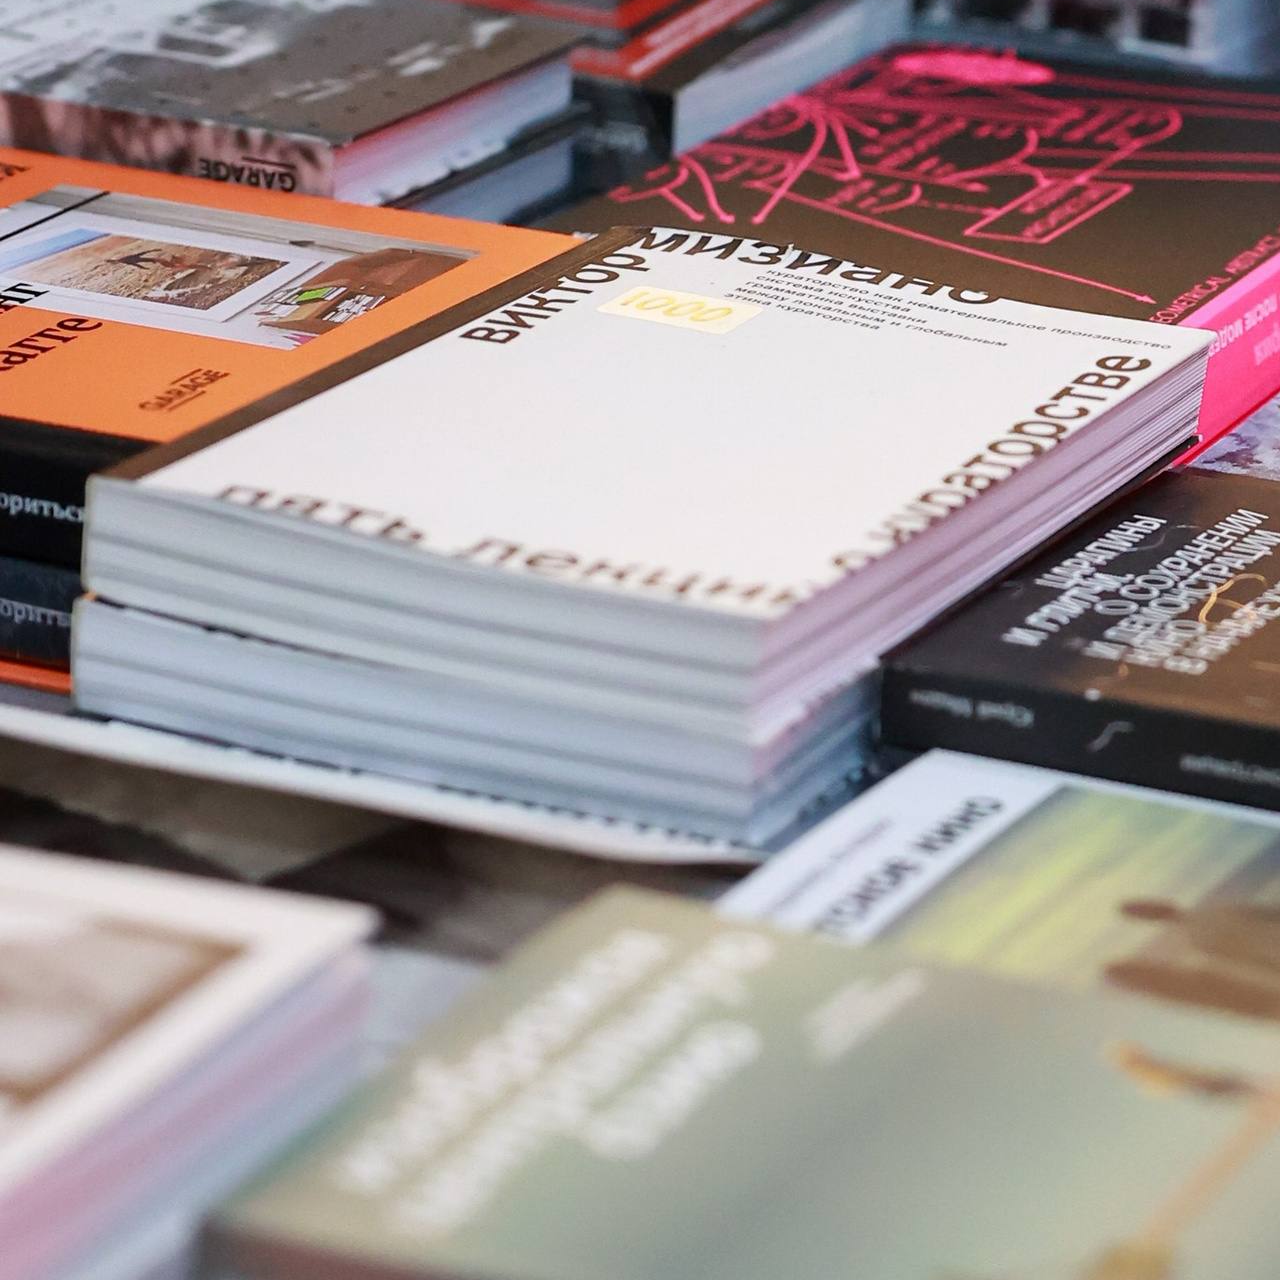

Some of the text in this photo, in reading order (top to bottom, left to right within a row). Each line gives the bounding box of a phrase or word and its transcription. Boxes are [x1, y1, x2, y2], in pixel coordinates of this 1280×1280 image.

[200, 157, 297, 193] GARAGE
[638, 229, 1001, 305] мизиано
[0, 282, 50, 315] нг
[459, 252, 652, 345] виктор
[620, 290, 734, 323] 1000
[723, 292, 881, 331] этика кураторства
[745, 281, 928, 325] грамматика выставки
[756, 275, 911, 313] система искусства
[766, 268, 1172, 350] кураторство как нематериальное производство
[1150, 272, 1232, 324] EOMETRICAL
[734, 286, 788, 303] между
[794, 297, 886, 324] локальным
[906, 322, 1008, 348] глобальным
[1207, 322, 1245, 358] МОДЕР
[138, 369, 231, 412] GARAGE
[868, 354, 1153, 543] кураторстве
[215, 483, 425, 548] пять
[1034, 513, 1168, 591] ЦАРАПИНЫ
[1094, 508, 1270, 617] О СОХРАНЕНИИ
[1002, 625, 1049, 647] И
[1083, 640, 1128, 661] И
